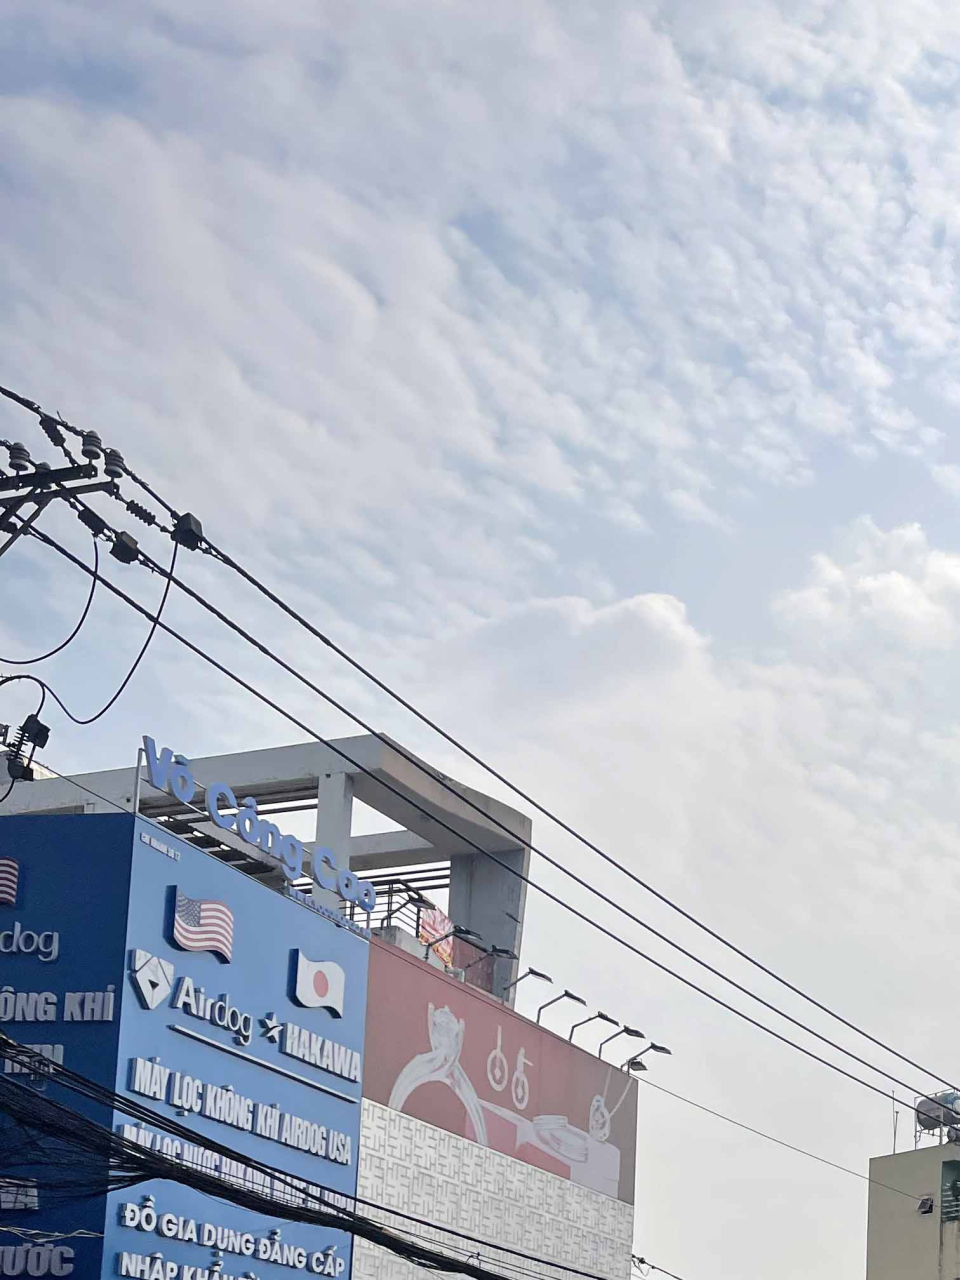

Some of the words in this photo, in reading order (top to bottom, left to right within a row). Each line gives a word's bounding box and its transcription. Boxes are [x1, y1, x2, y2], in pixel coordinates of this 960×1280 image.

[63, 984, 115, 1022] KHÍ
[171, 976, 253, 1046] Airdog
[280, 1022, 361, 1083] HAKAWA
[131, 1056, 170, 1100] MÁY
[171, 1071, 203, 1117] LỌC
[203, 1083, 253, 1131] KHÔNG
[254, 1103, 280, 1140] KHÍ
[281, 1113, 327, 1157] AIRDOG
[327, 1129, 352, 1165] USA
[122, 1194, 157, 1232] ĐỒ
[158, 1213, 198, 1243] GIA
[202, 1222, 255, 1257] DỤNG
[258, 1229, 307, 1269] ĐẲNG
[310, 1245, 345, 1277] CẤP
